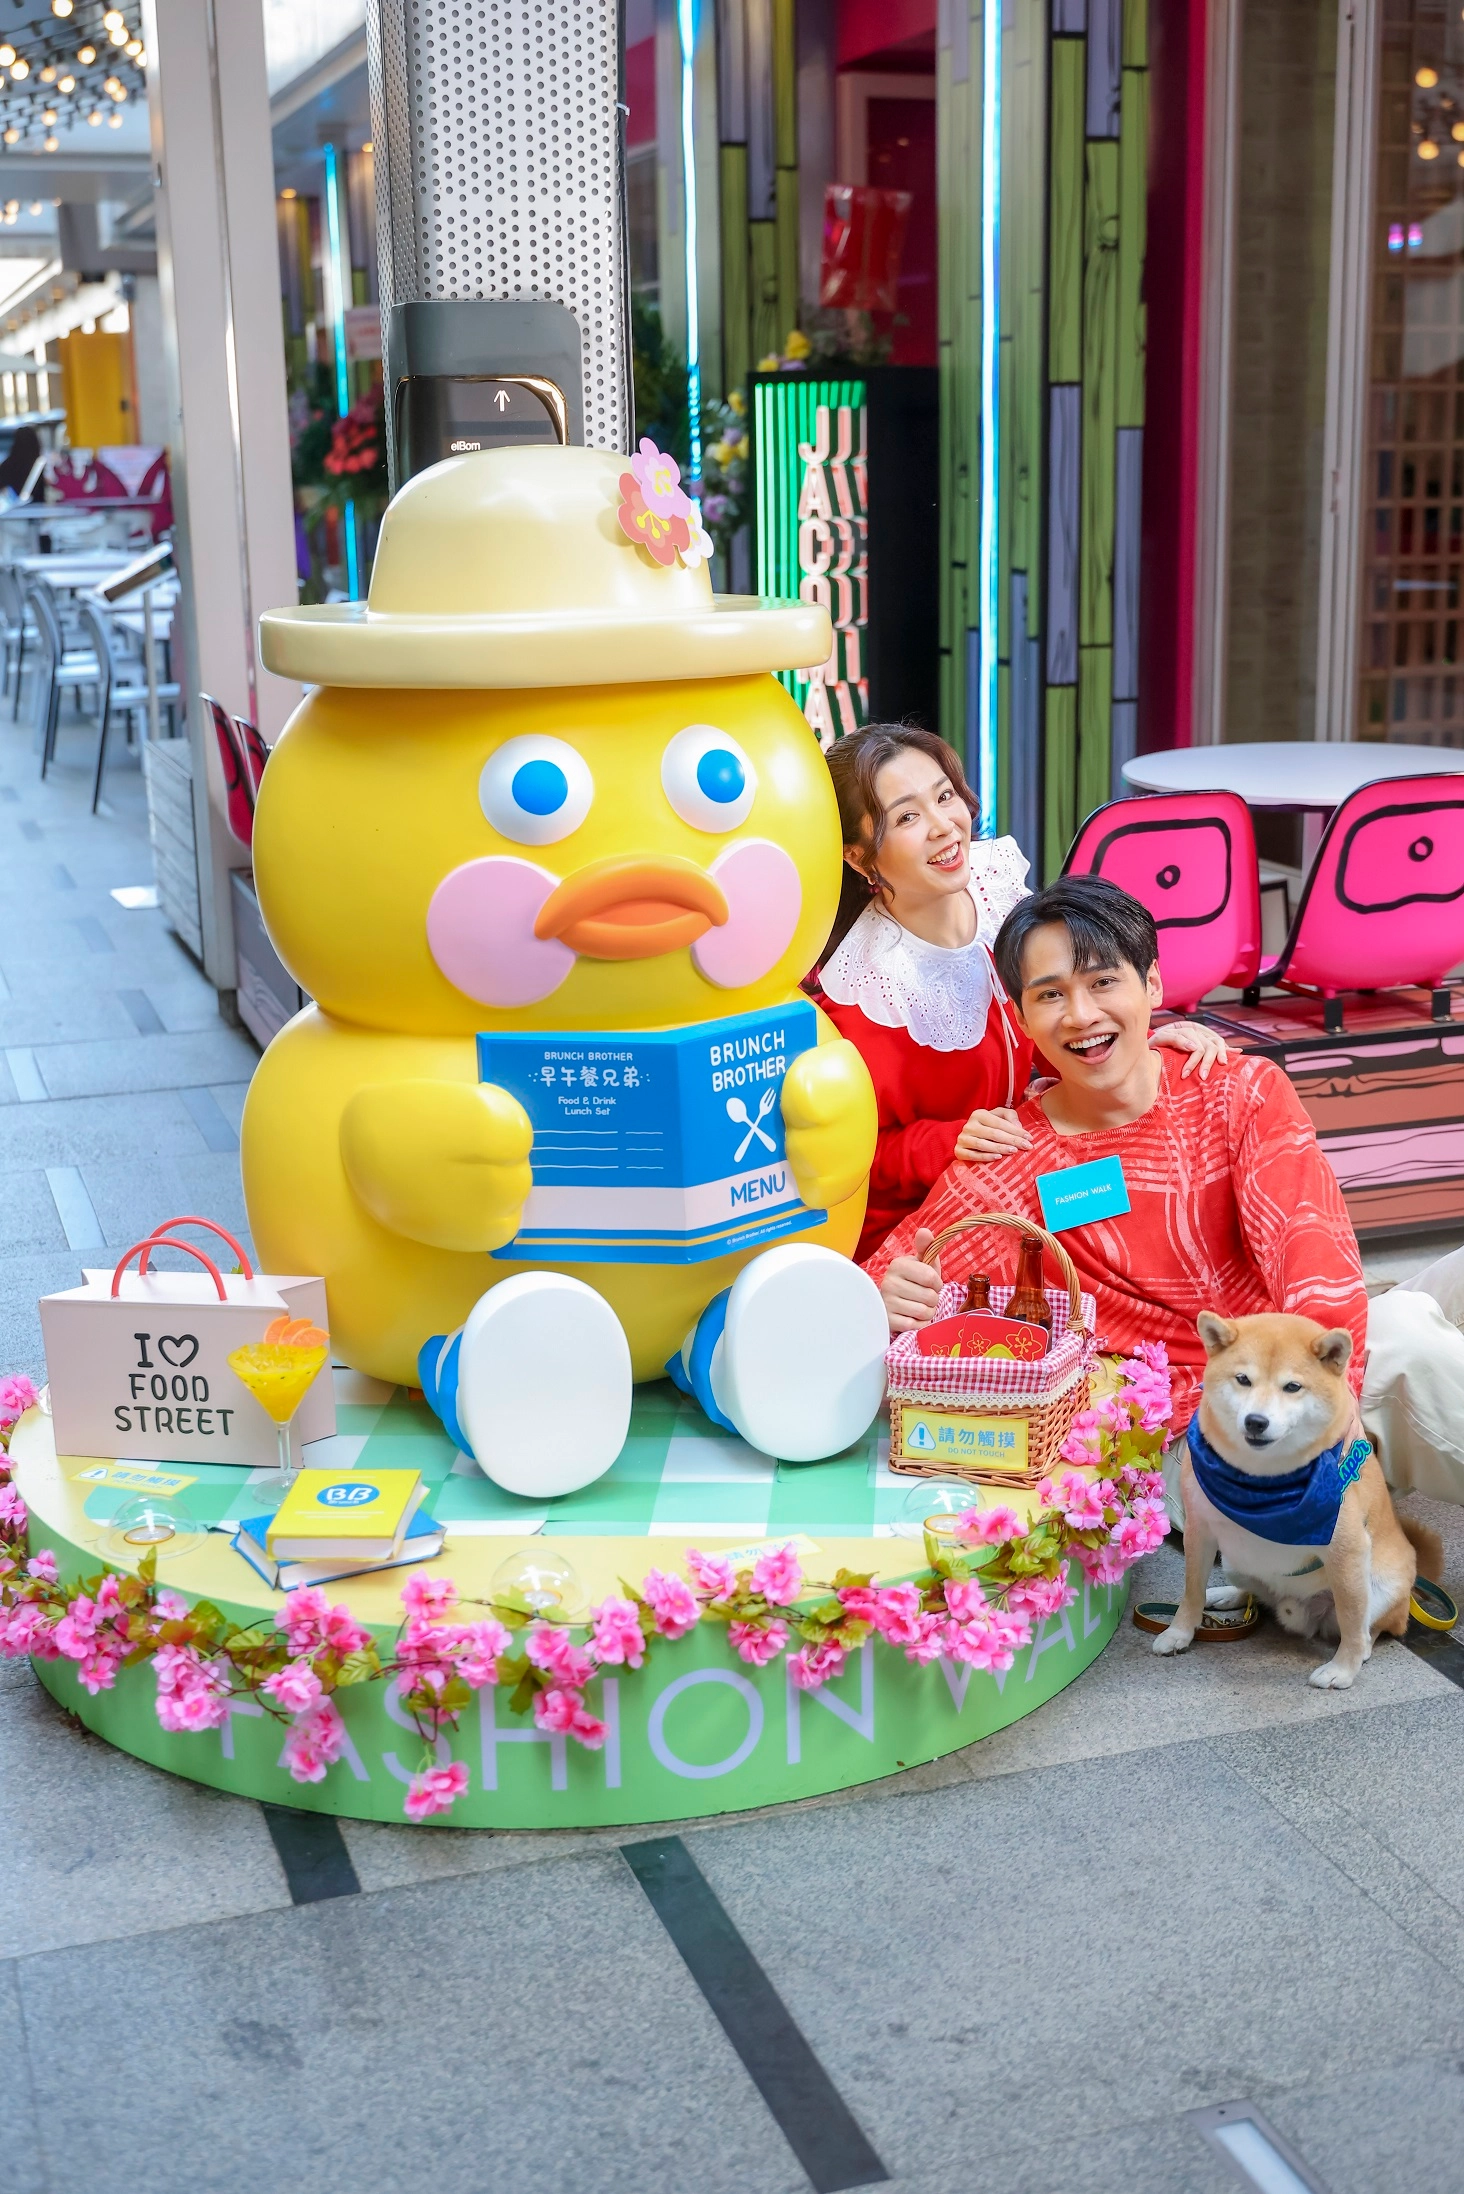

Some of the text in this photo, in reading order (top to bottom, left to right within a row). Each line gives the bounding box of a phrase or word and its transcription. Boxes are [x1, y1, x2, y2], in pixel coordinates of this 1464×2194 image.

[544, 1051, 633, 1062] BRUNCH BROTHER
[710, 1029, 785, 1066] BRUNCH
[540, 1065, 640, 1089] 早午餐兄弟
[712, 1055, 786, 1093] BROTHER
[558, 1096, 617, 1105] Food & Drink
[564, 1107, 611, 1116] Lunch Set
[730, 1171, 786, 1207] MENU
[1055, 1183, 1113, 1206] FASHION WALK
[134, 1332, 154, 1368] I
[128, 1373, 210, 1402] FOOD
[114, 1405, 235, 1436] STREET
[938, 1426, 1016, 1449] 請勿觸摸
[948, 1446, 1005, 1458] DO NOT TOUCH
[326, 1487, 373, 1501] BB
